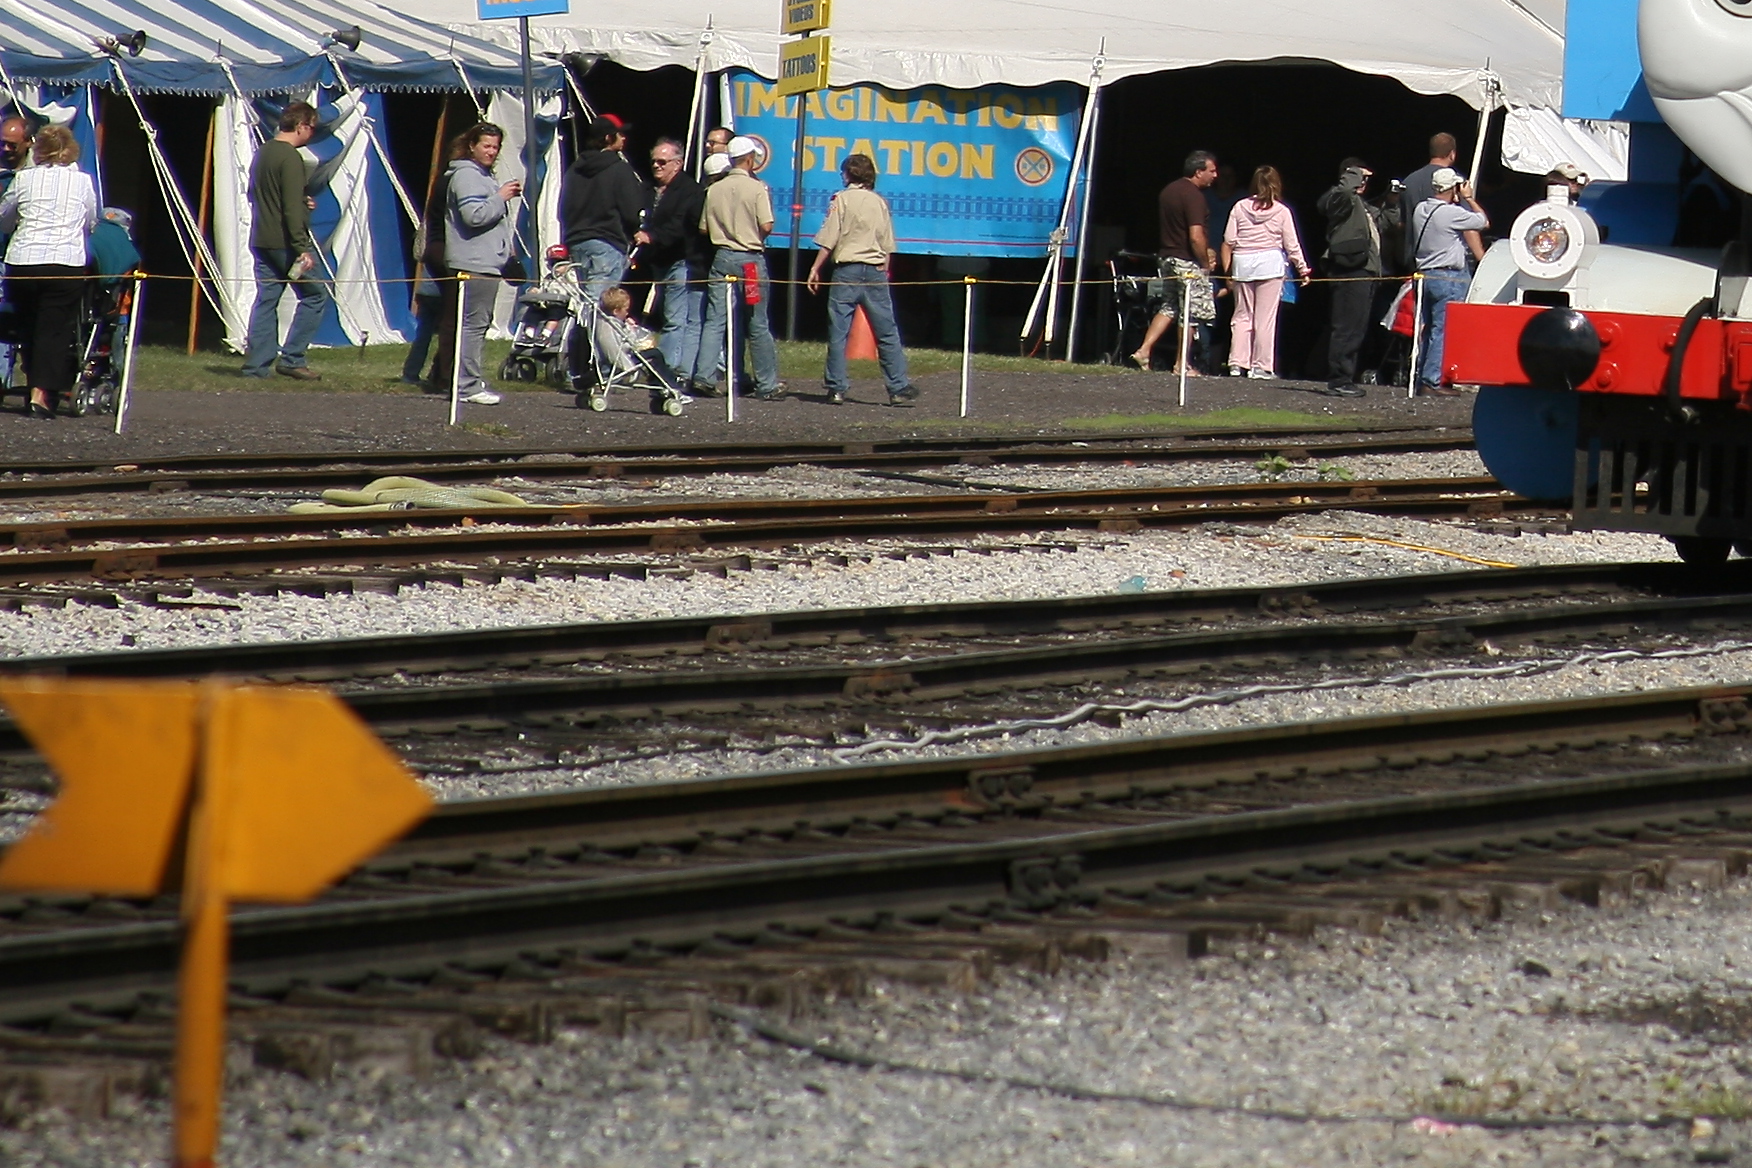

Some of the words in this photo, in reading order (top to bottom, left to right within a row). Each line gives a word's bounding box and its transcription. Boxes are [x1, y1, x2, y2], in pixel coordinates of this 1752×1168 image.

[788, 4, 814, 24] VIDEOS
[782, 53, 816, 79] TATTOOS
[734, 81, 1059, 132] IMAGINATION
